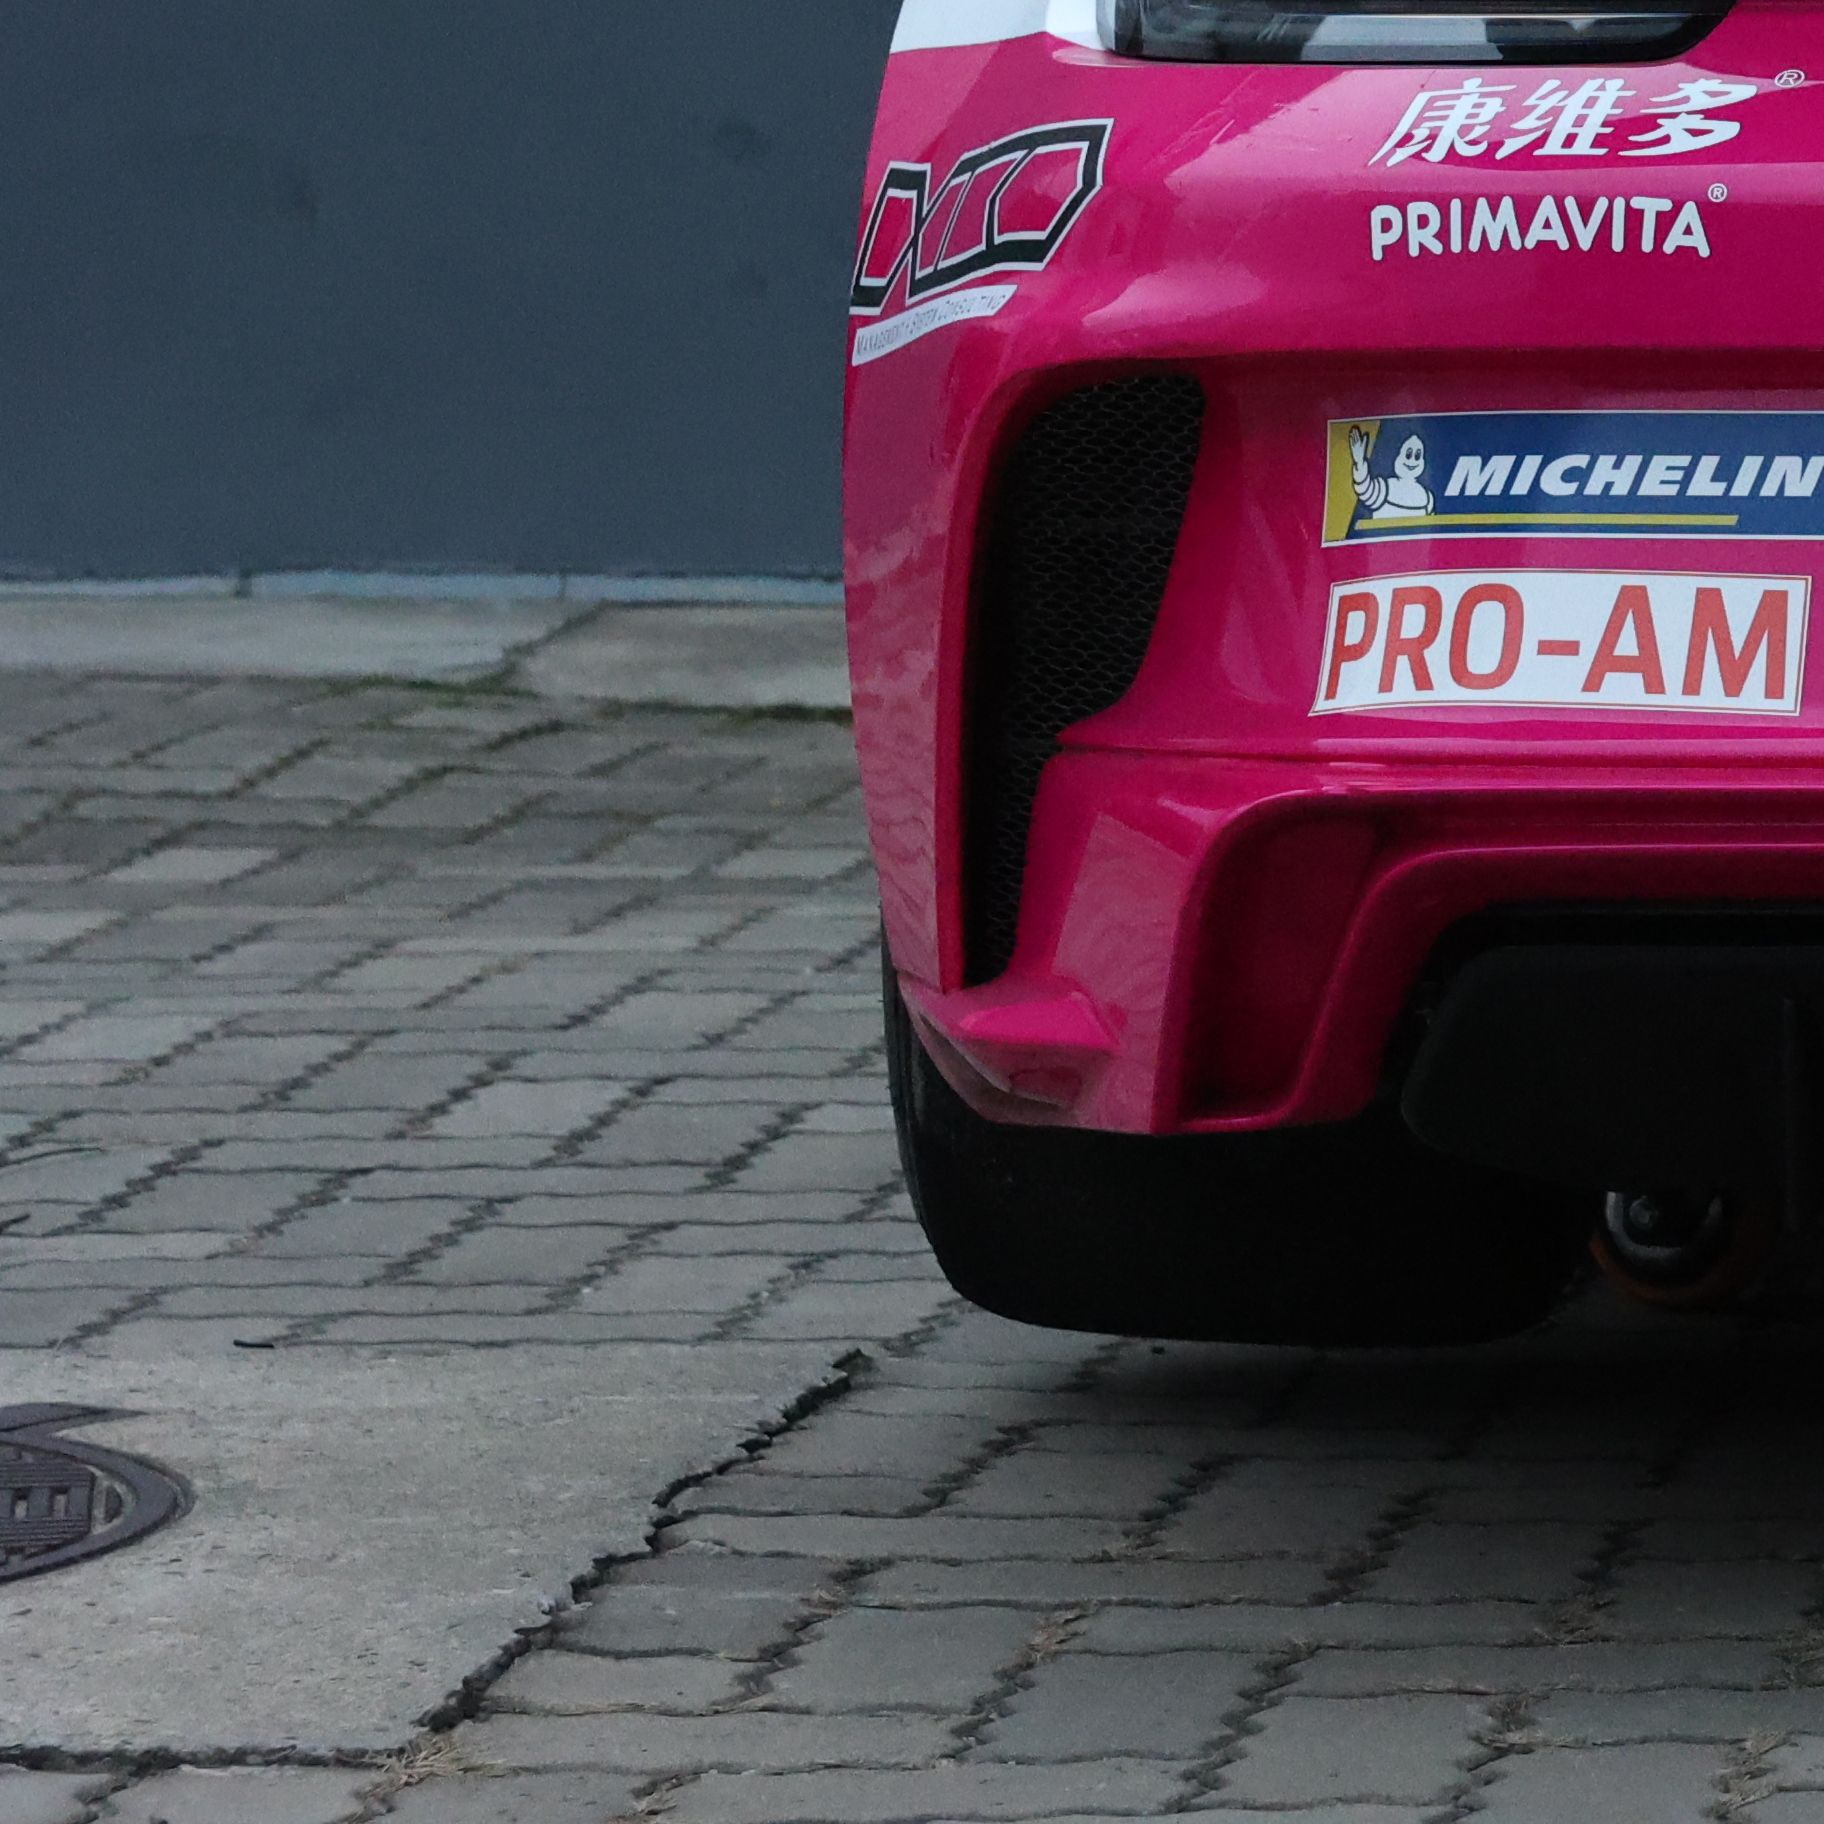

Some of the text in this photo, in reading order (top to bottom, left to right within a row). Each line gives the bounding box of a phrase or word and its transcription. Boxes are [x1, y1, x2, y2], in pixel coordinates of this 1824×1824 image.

[1368, 76, 1758, 167] 康维多
[1370, 194, 1711, 261] PRIMAVITA
[1324, 583, 1789, 700] PRO-AM
